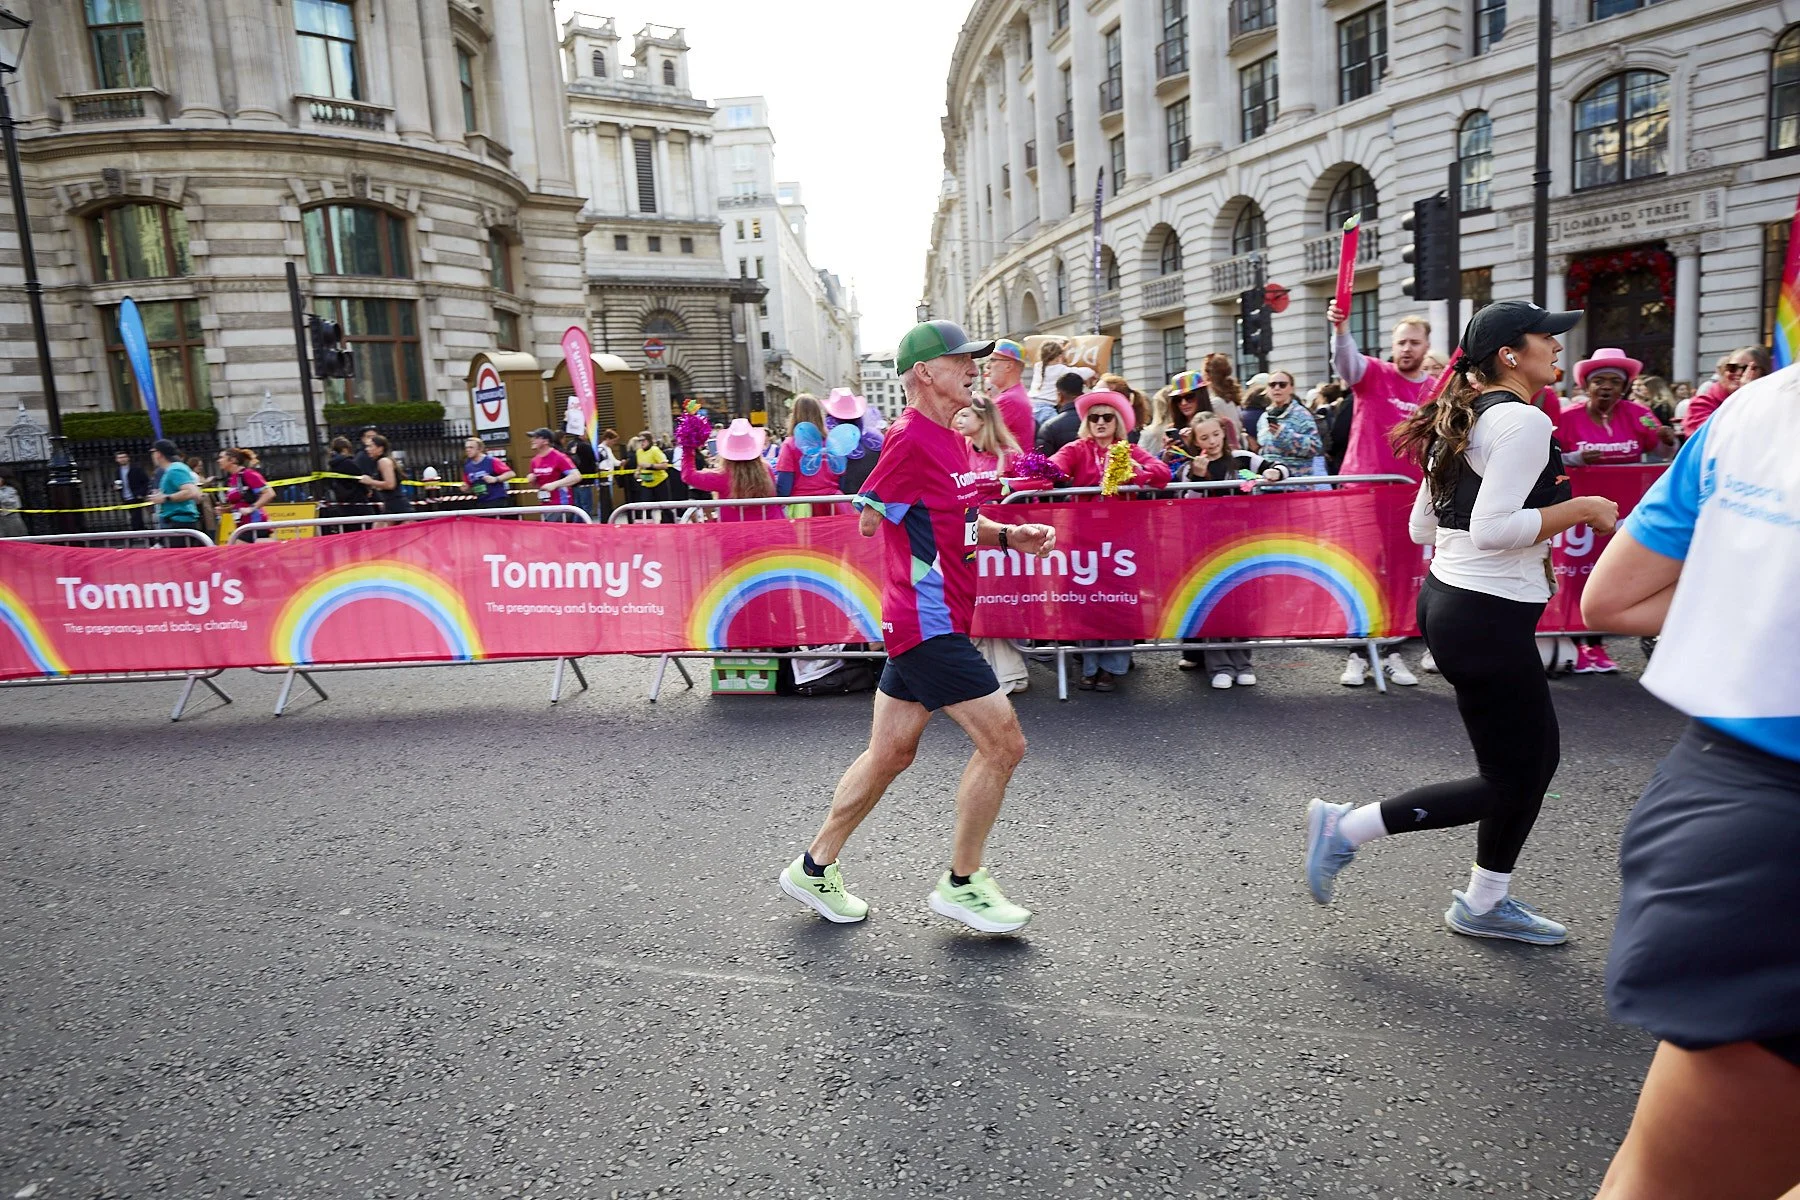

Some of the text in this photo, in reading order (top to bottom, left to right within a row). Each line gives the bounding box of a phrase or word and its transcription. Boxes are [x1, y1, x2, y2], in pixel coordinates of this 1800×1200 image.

[1564, 212, 1632, 232] LOMBARD
[1637, 201, 1690, 219] STREET
[1576, 440, 1639, 453] Tommy's
[978, 541, 1137, 586] mmy's
[1554, 563, 1577, 577] aby
[483, 554, 663, 598] Tommy's
[56, 572, 244, 616] Tommy's
[1021, 591, 1048, 603] and
[1051, 591, 1086, 605] baby
[1089, 591, 1138, 605] charity
[487, 602, 664, 616] The pregnancy and baby charity
[64, 619, 247, 635] The pregnancy and baby charity
